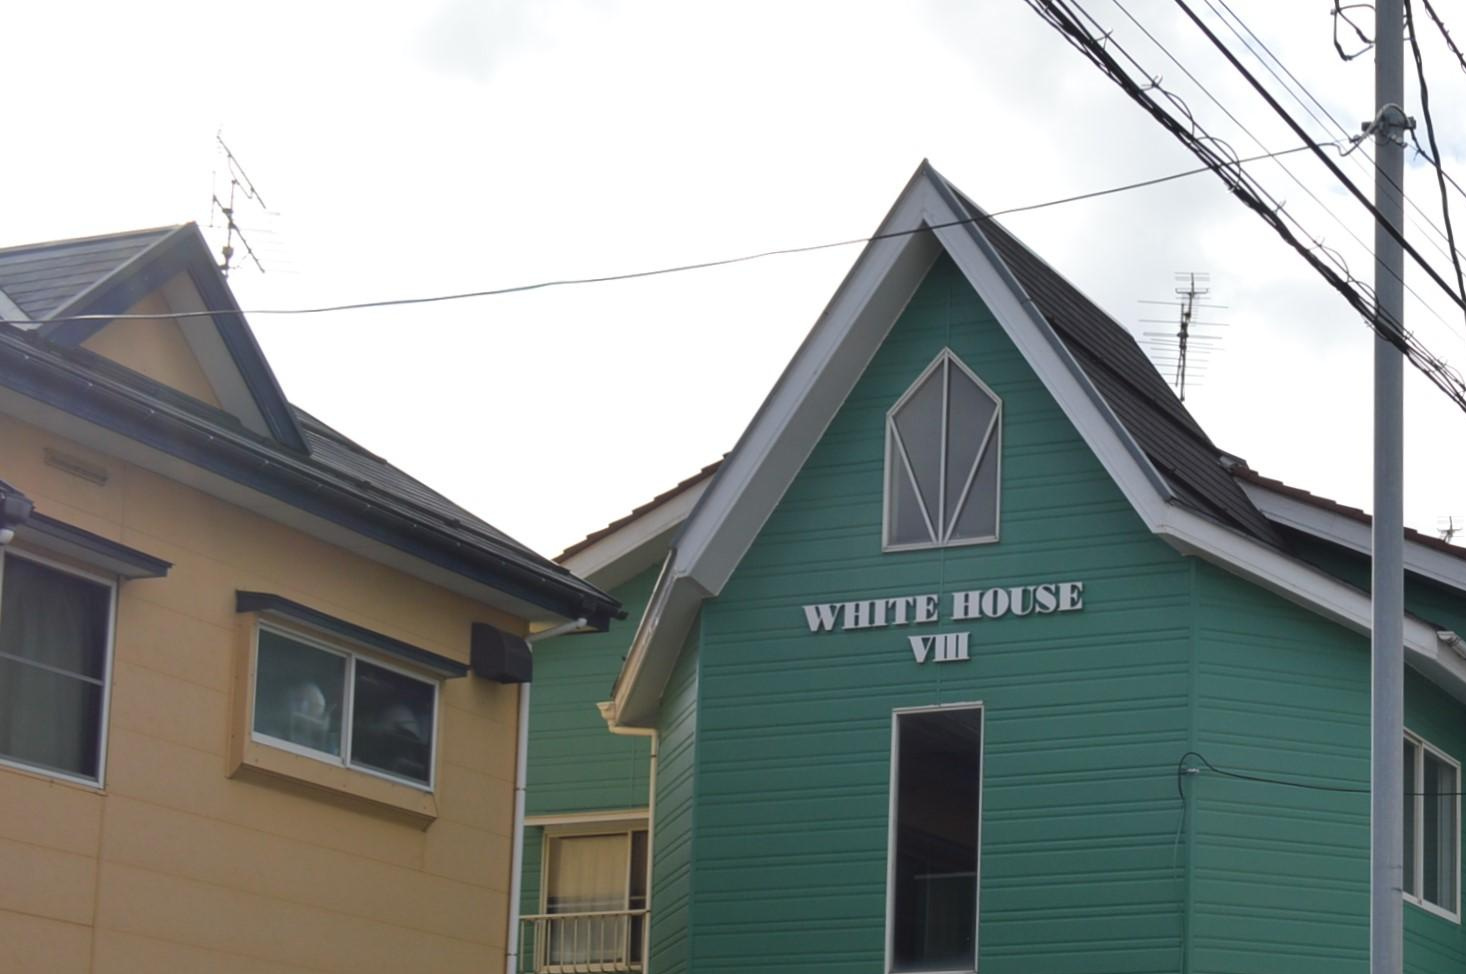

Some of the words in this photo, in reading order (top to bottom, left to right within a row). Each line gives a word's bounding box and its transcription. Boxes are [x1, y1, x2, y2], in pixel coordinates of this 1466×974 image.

[802, 594, 939, 632] WHITE
[951, 581, 1083, 620] HOUSE
[908, 631, 971, 663] VIII
